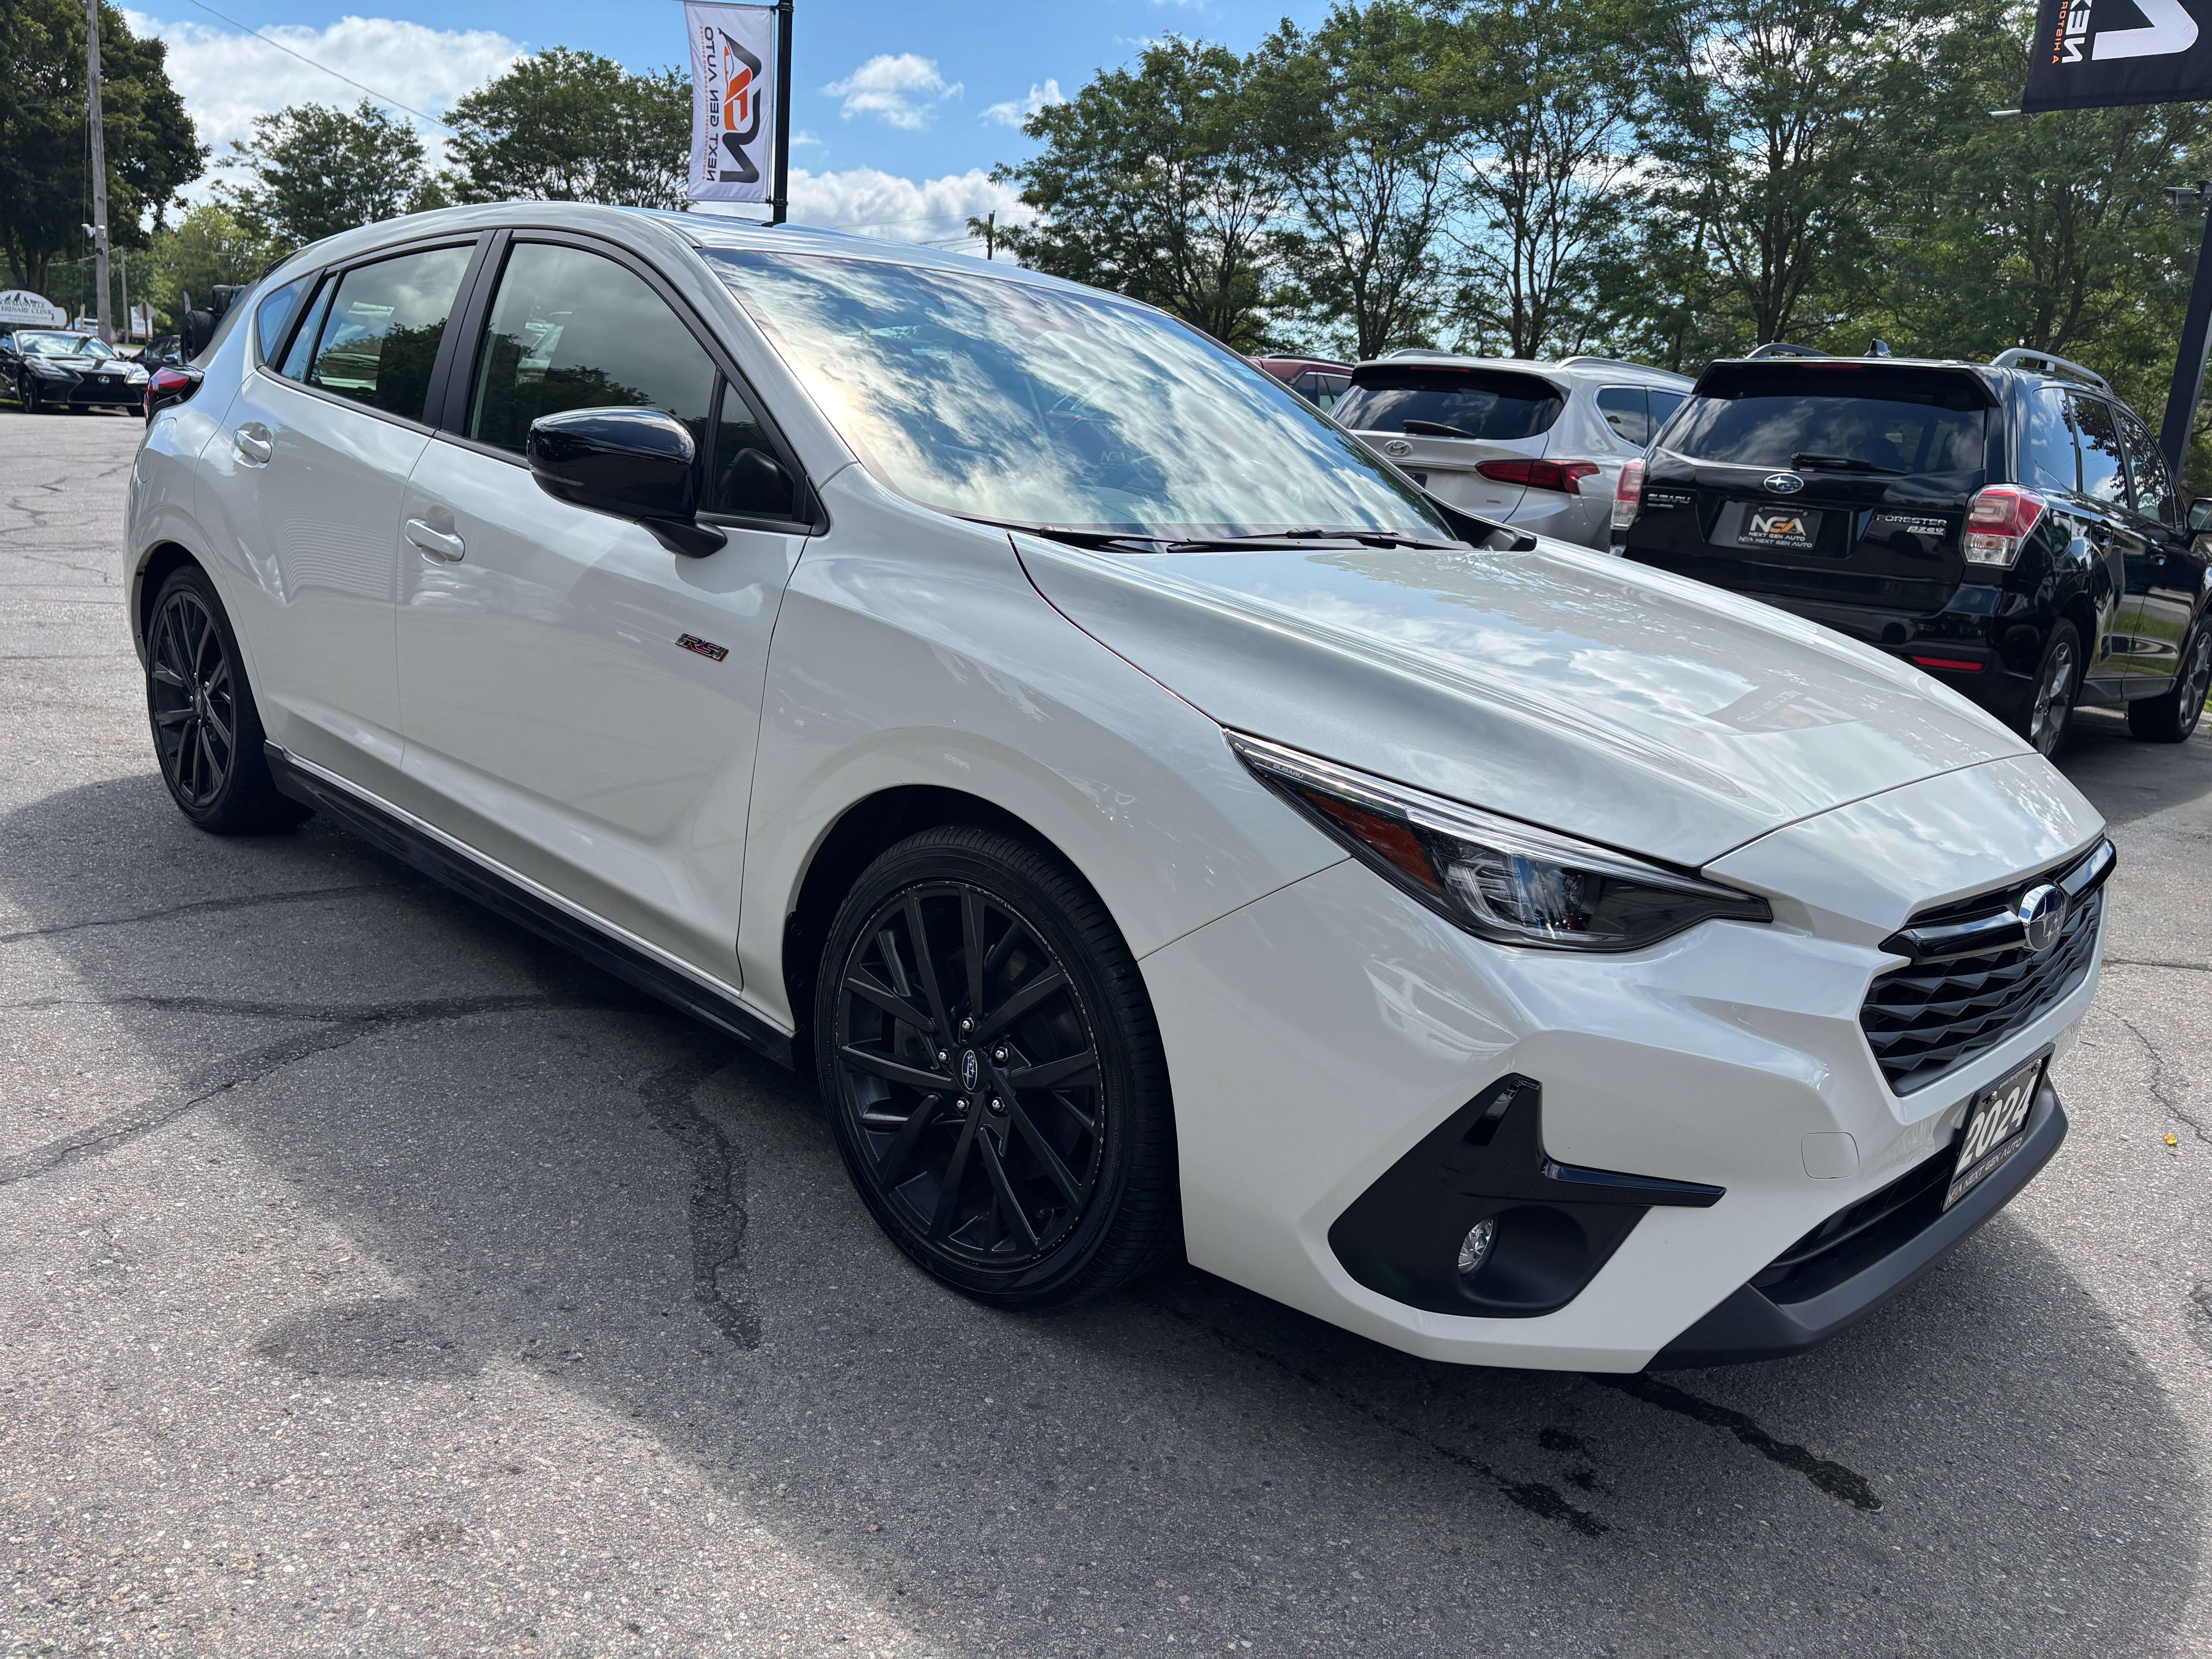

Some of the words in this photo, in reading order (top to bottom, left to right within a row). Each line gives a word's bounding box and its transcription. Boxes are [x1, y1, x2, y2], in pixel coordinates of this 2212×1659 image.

[1648, 493, 1691, 504] SUBARU
[1750, 514, 1806, 536] NGA
[1877, 514, 1947, 526] FORESTER
[1273, 764, 1304, 778] SUBARU
[1956, 1073, 2038, 1175] 2024
[1963, 1165, 1985, 1189] NEXT
[1985, 1152, 2001, 1171] GEN
[2001, 1137, 2022, 1159] AUTO
